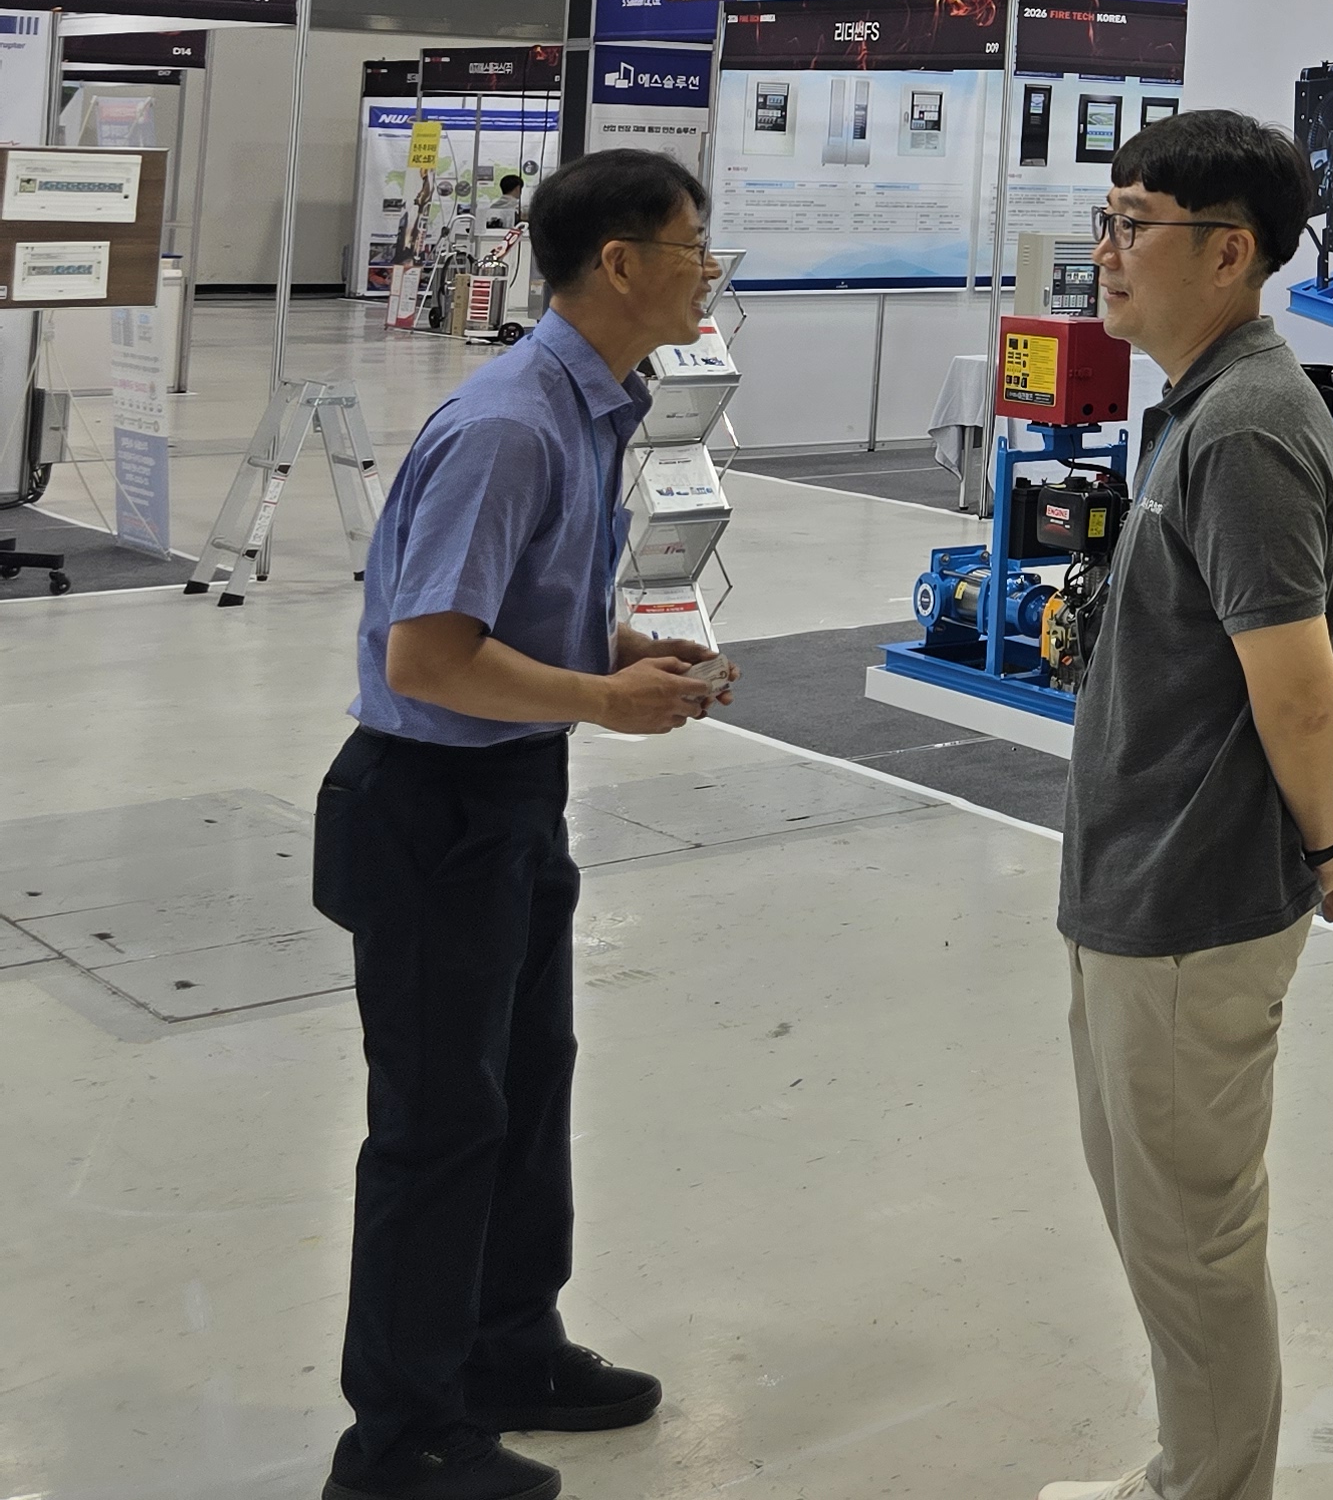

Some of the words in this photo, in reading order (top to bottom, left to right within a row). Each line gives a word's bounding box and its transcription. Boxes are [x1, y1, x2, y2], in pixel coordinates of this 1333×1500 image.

[1023, 7, 1047, 19] 2026
[1049, 9, 1071, 21] FIRE
[1072, 10, 1095, 22] TECH
[1096, 12, 1127, 25] KOREA
[172, 47, 192, 56] D14
[986, 42, 999, 54] D09
[638, 74, 699, 90] 에스솔루션
[1047, 505, 1069, 518] ENGINE
